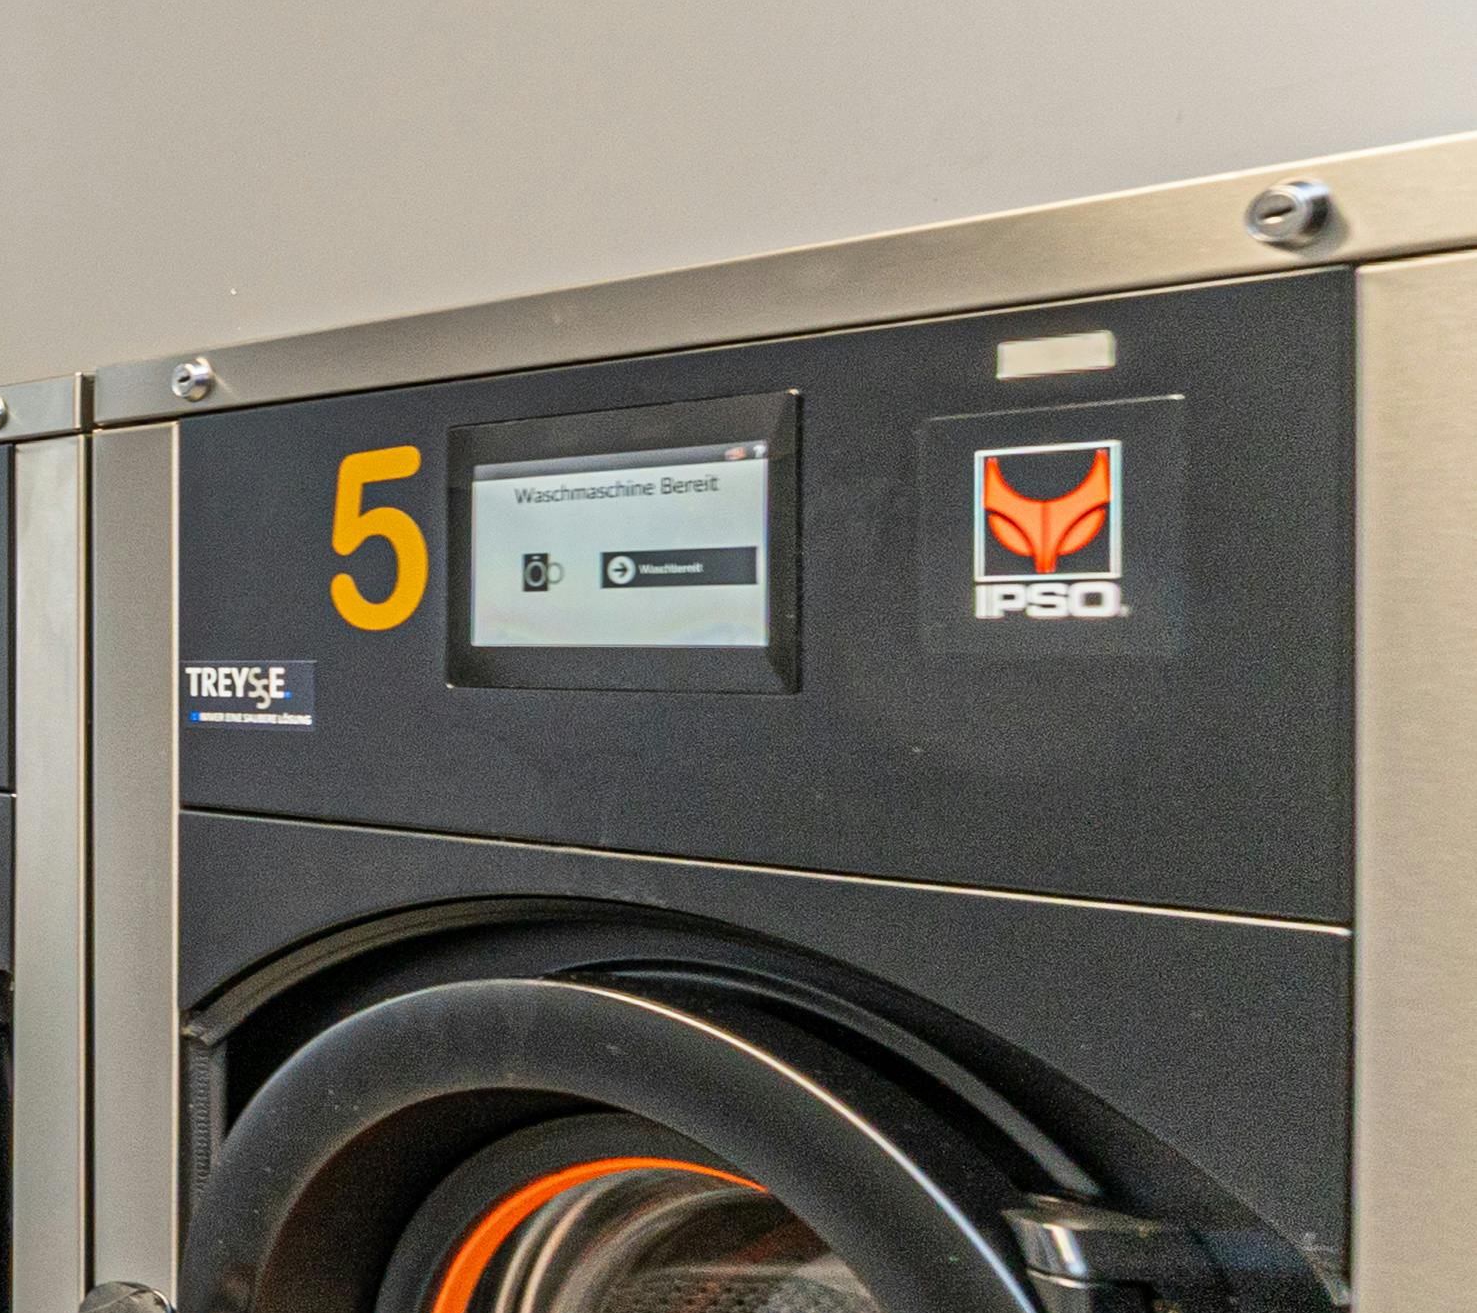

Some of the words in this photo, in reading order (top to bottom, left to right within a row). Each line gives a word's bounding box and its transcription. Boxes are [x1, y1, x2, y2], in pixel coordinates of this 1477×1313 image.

[513, 479, 656, 504] Waschmaschine
[660, 474, 721, 496] Bereit
[330, 445, 429, 631] 5
[975, 581, 1120, 620] IPSO
